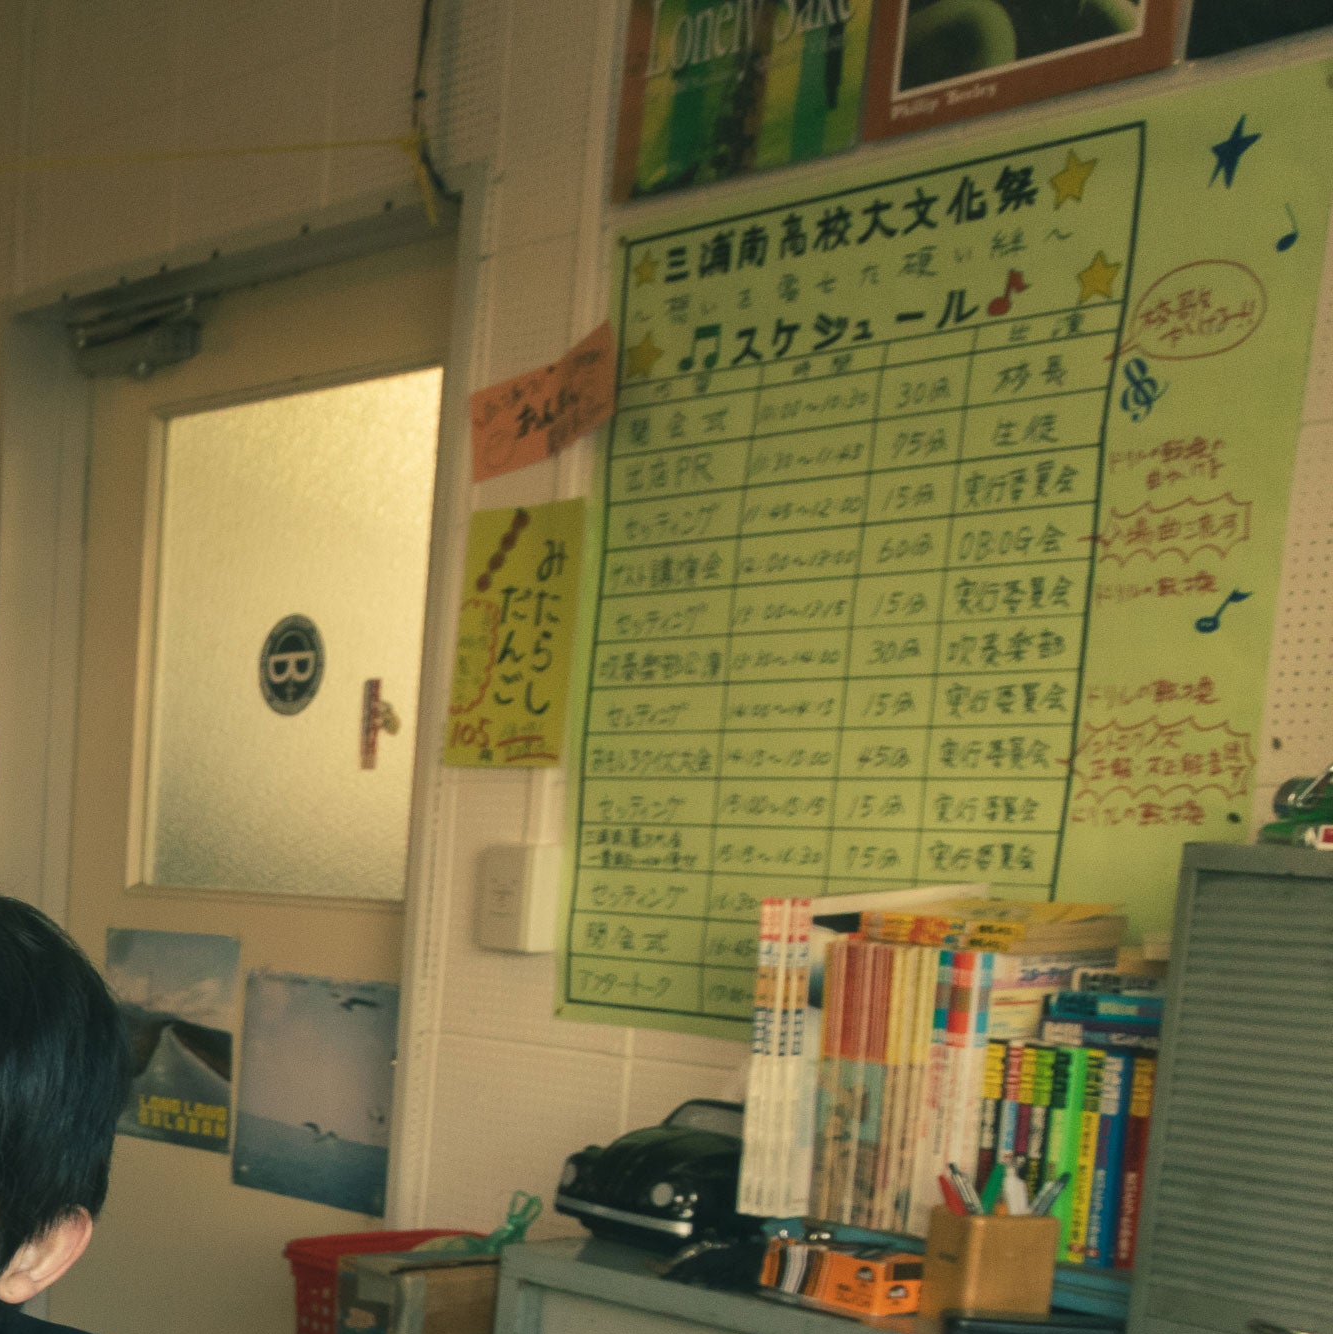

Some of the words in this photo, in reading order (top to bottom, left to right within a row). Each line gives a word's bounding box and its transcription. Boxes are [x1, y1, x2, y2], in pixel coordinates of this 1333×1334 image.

[732, 289, 979, 365] スケジュール
[494, 587, 532, 705] だんご
[525, 539, 567, 715] みたらし
